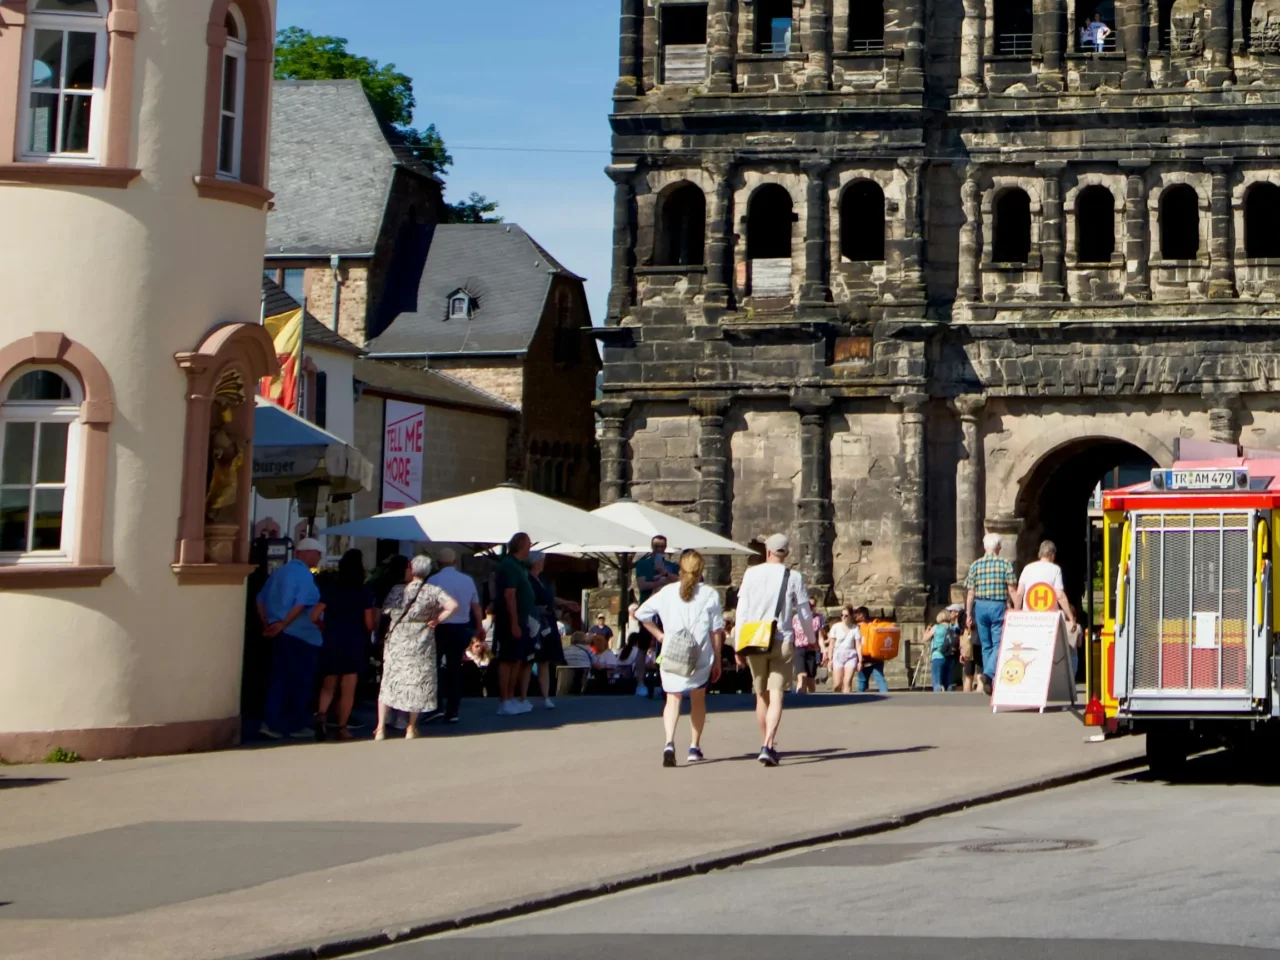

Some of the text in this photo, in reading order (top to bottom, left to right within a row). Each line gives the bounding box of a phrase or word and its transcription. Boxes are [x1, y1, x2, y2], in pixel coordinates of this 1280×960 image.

[387, 420, 423, 452] TELL ME
[385, 456, 411, 487] MORE
[1173, 472, 1232, 484] TR AM 479
